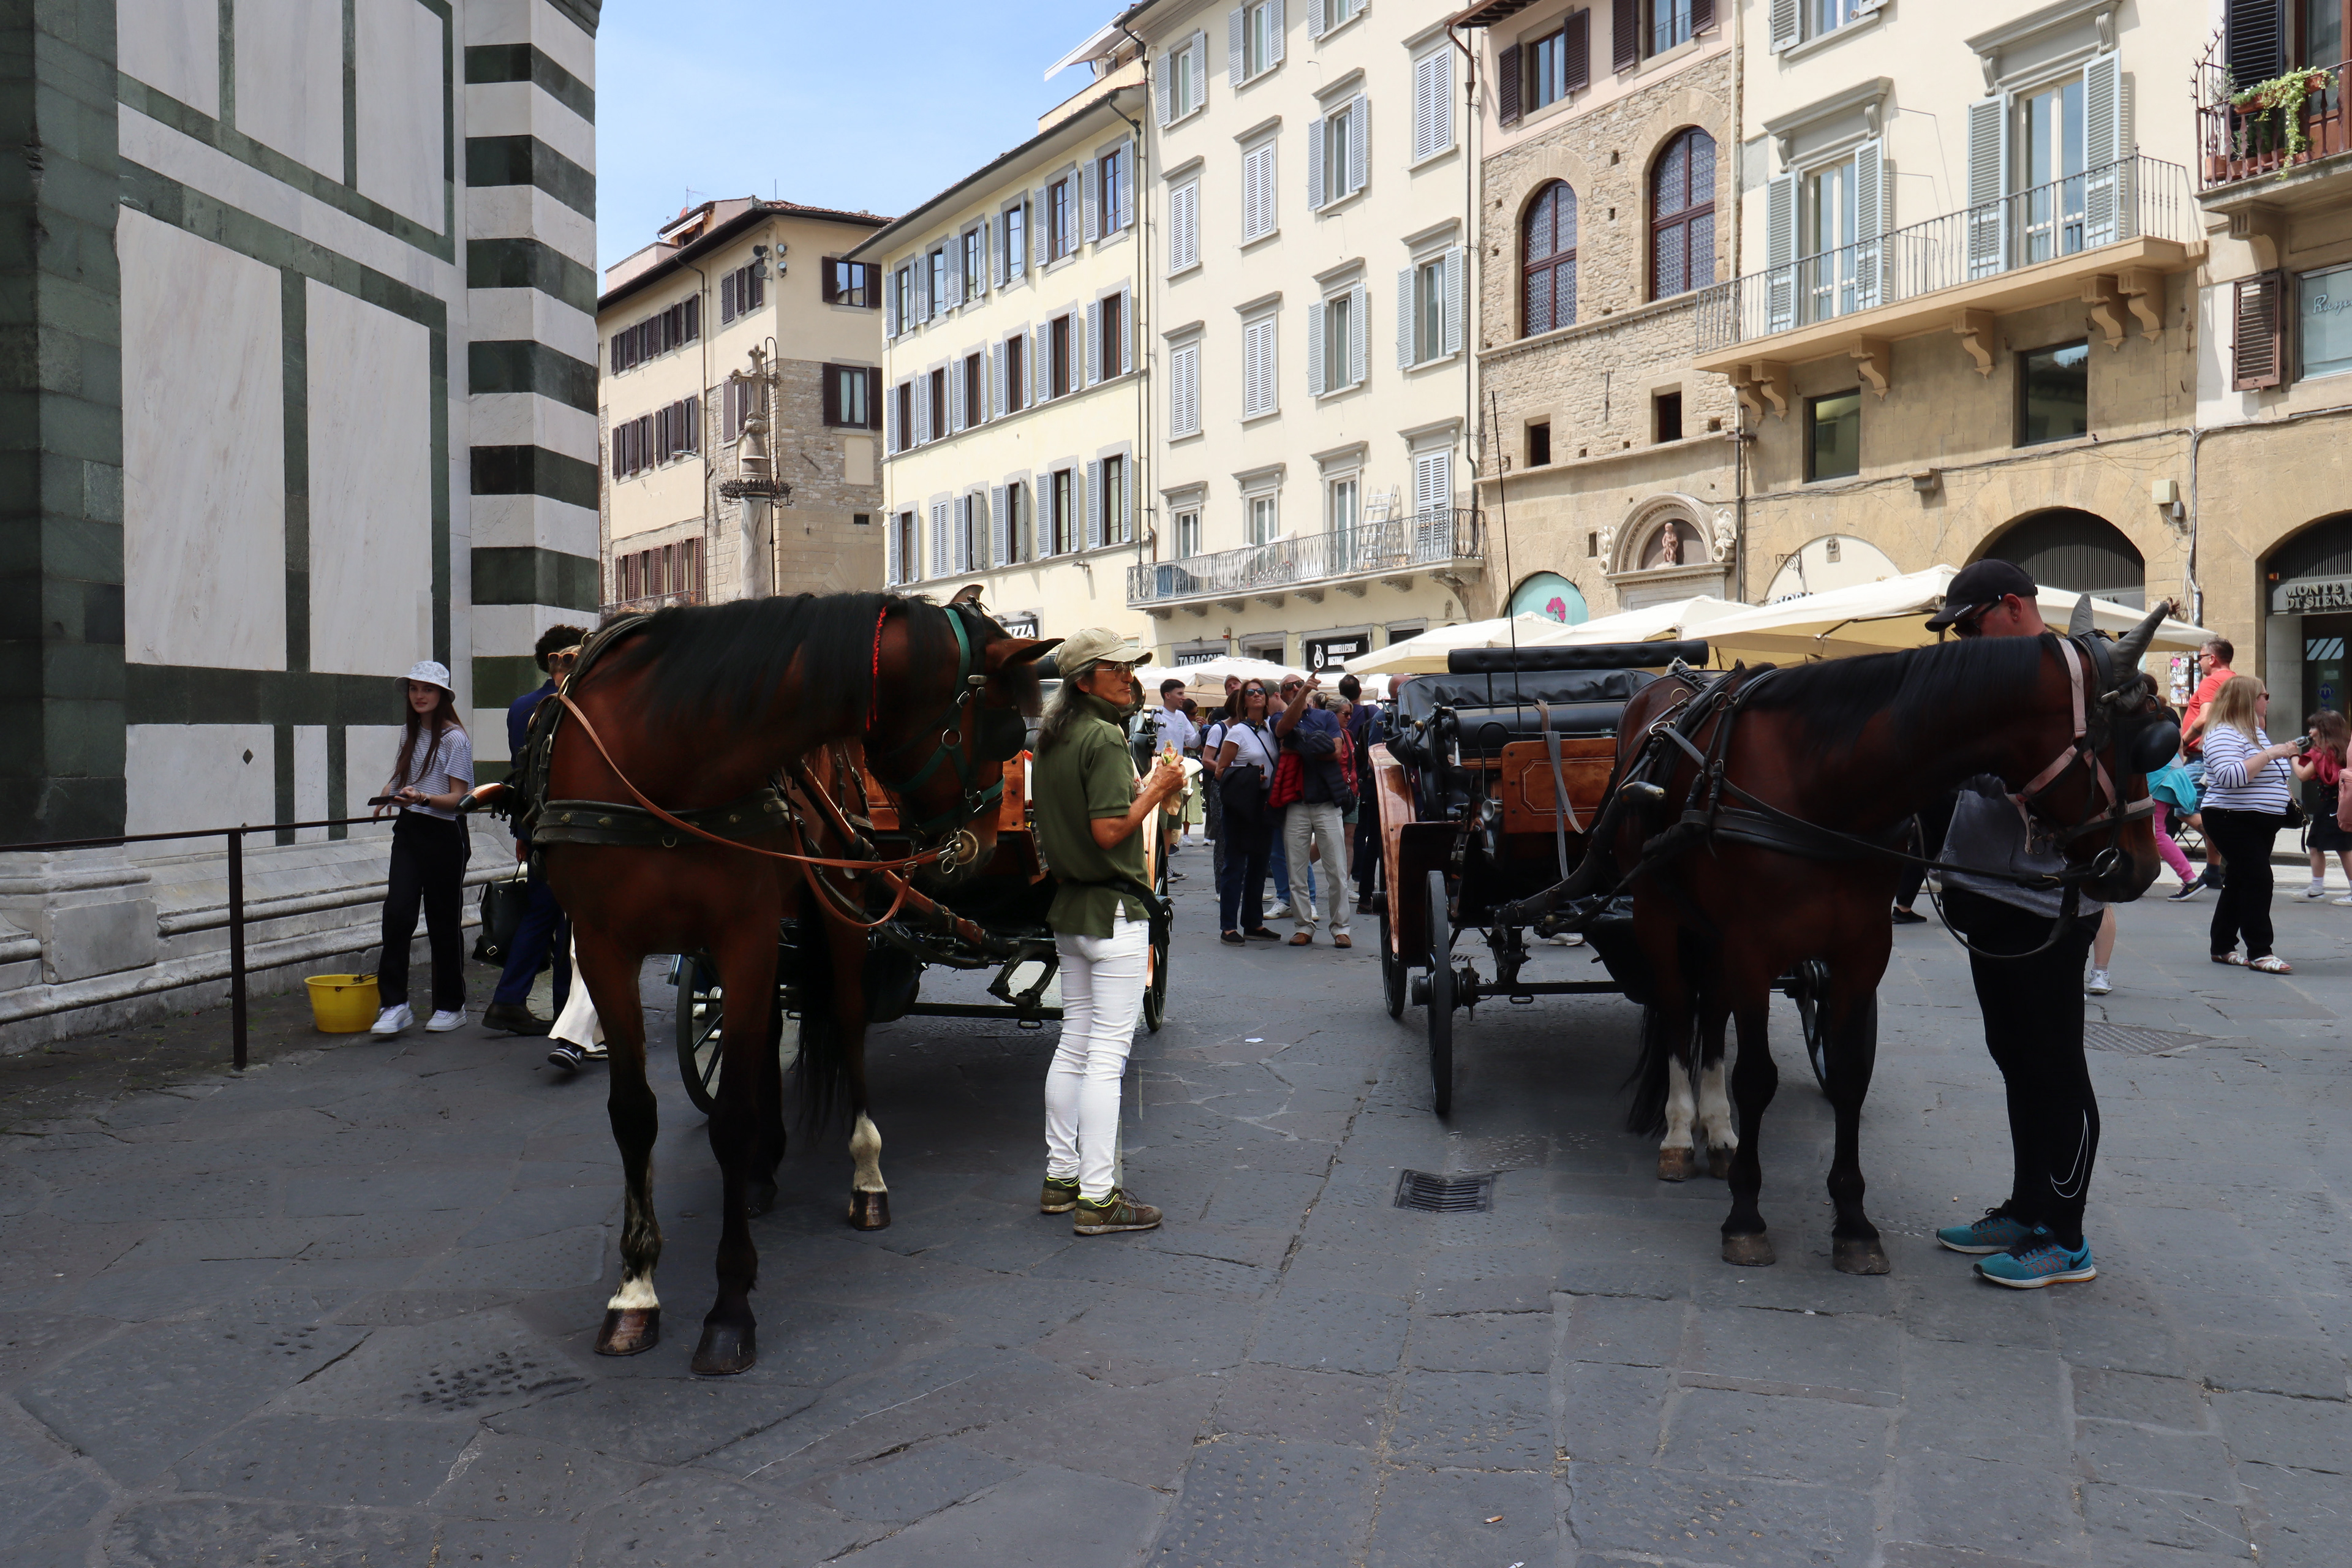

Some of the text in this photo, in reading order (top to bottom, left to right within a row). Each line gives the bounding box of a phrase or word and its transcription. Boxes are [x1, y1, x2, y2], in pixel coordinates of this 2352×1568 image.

[2286, 582, 2343, 597] MONTE
[2288, 594, 2352, 609] DI SIENA
[1954, 604, 1973, 617] ARTENGO
[1178, 653, 1224, 666] TABACC
